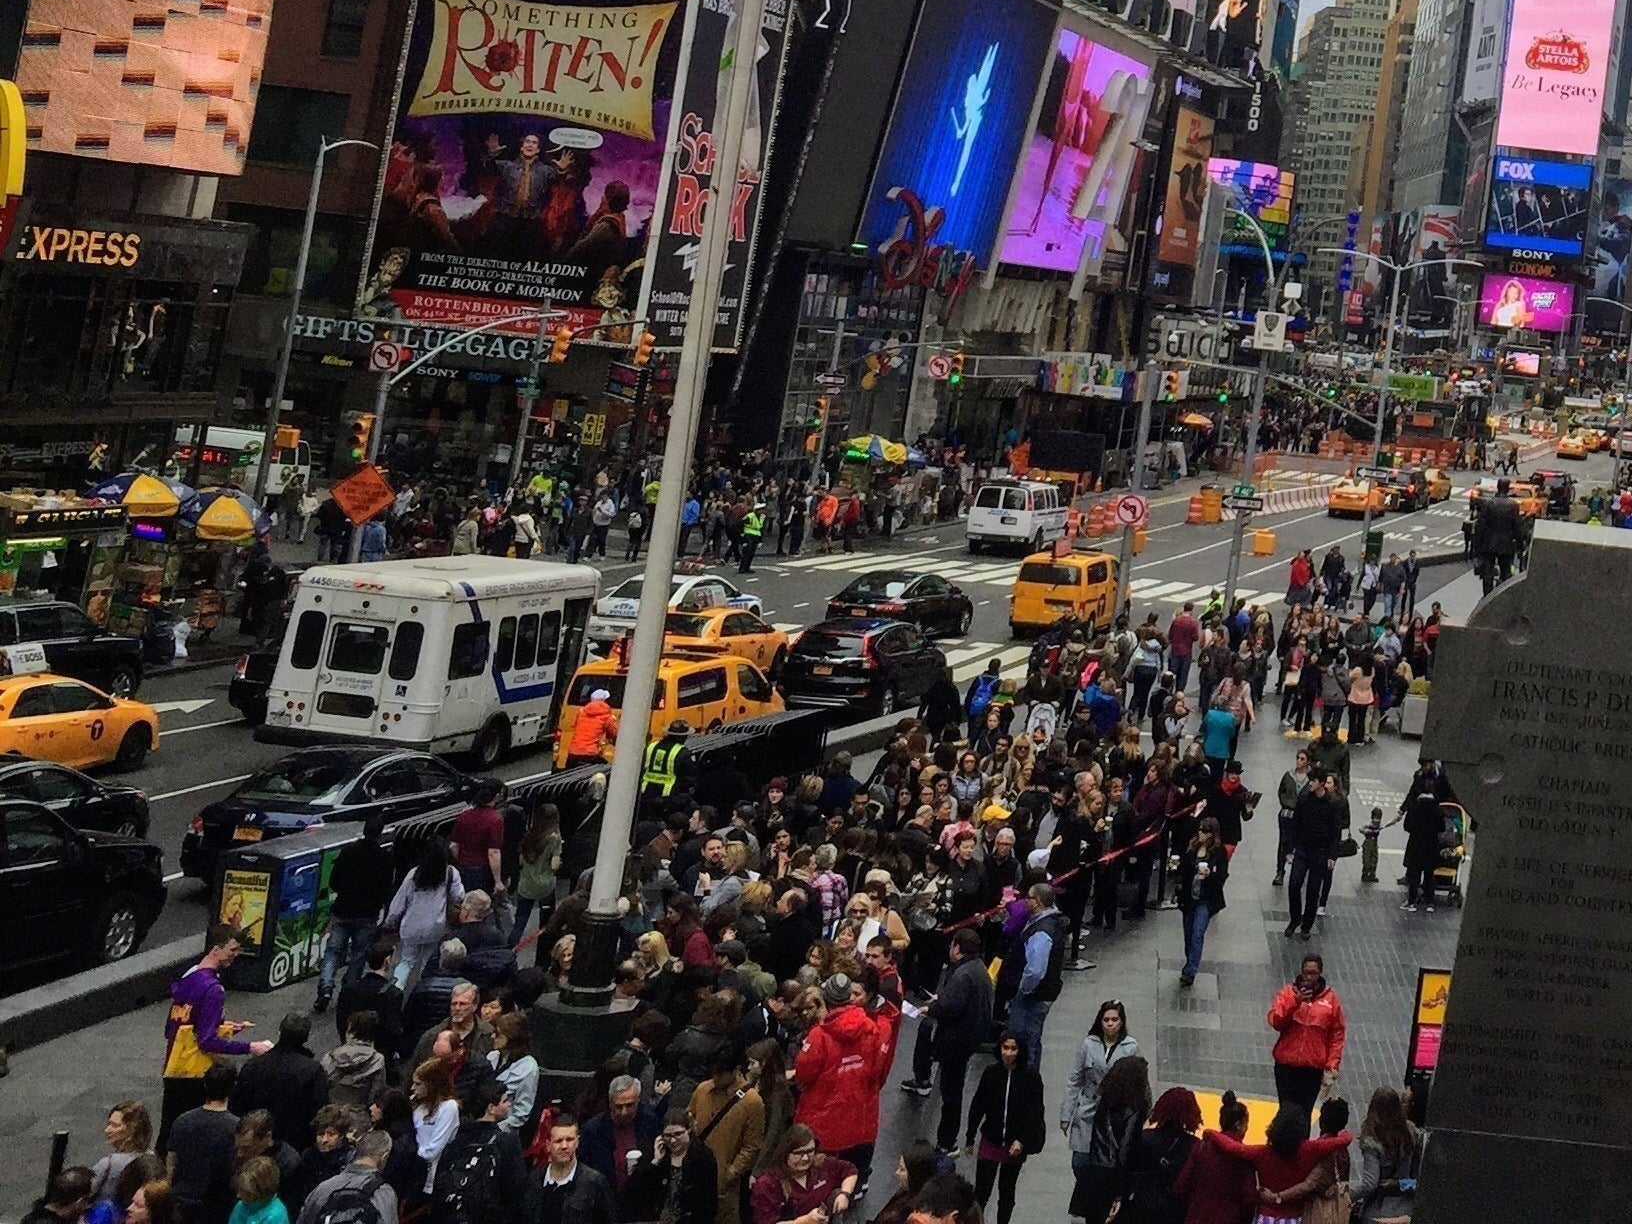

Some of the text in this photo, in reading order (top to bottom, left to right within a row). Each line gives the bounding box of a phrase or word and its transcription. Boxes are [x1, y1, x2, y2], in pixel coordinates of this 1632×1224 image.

[1536, 54, 1579, 66] ARTOIS
[1538, 44, 1579, 56] STELLA
[1512, 74, 1598, 103] Be Legacy
[1499, 160, 1535, 181] FOX
[16, 226, 141, 267] EXPRESS
[1512, 249, 1554, 261] SONY
[421, 252, 588, 277] FROM THE DIRECTOR OF ALADDIN
[445, 266, 466, 275] AND
[468, 268, 486, 277] THE
[1509, 260, 1557, 277] ECONOMIC
[418, 274, 583, 301] THE BOOK OF MORMON
[283, 313, 552, 363] GIFTS LUGGAGE
[321, 355, 354, 367] Nikon
[416, 366, 459, 378] SONY
[1492, 679, 1578, 707] FRANCIS
[1510, 733, 1586, 754] CATHOLIC
[1538, 775, 1611, 796] CHAPLAIN
